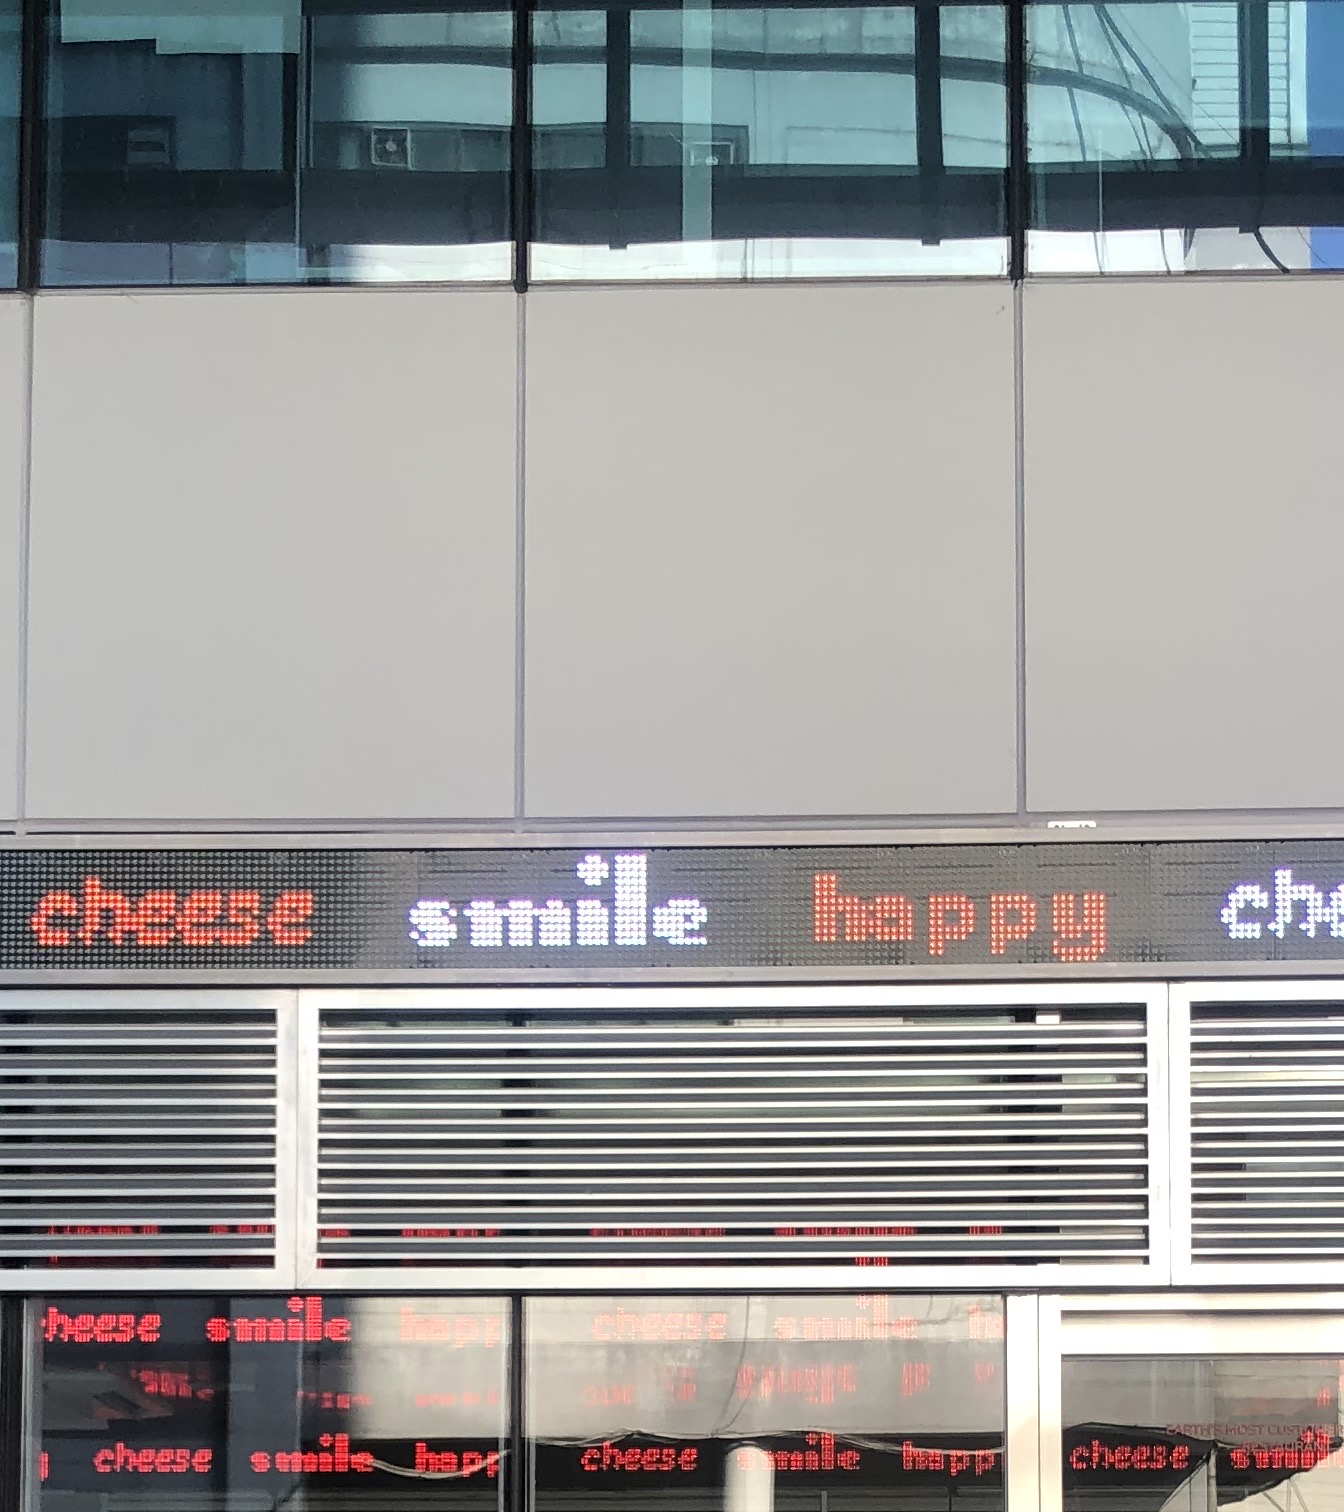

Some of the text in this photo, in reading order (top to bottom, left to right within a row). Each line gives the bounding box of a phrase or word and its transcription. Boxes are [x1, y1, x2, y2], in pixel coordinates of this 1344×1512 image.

[31, 876, 313, 946] cheese
[408, 852, 709, 947] smile
[814, 873, 1106, 961] happy
[41, 1307, 162, 1343] heese
[205, 1296, 352, 1343] smile
[93, 1442, 213, 1474] cheese
[249, 1433, 375, 1473] smile
[580, 1441, 699, 1472] cheese
[736, 1432, 861, 1471] smile
[1068, 1438, 1190, 1470] cheese
